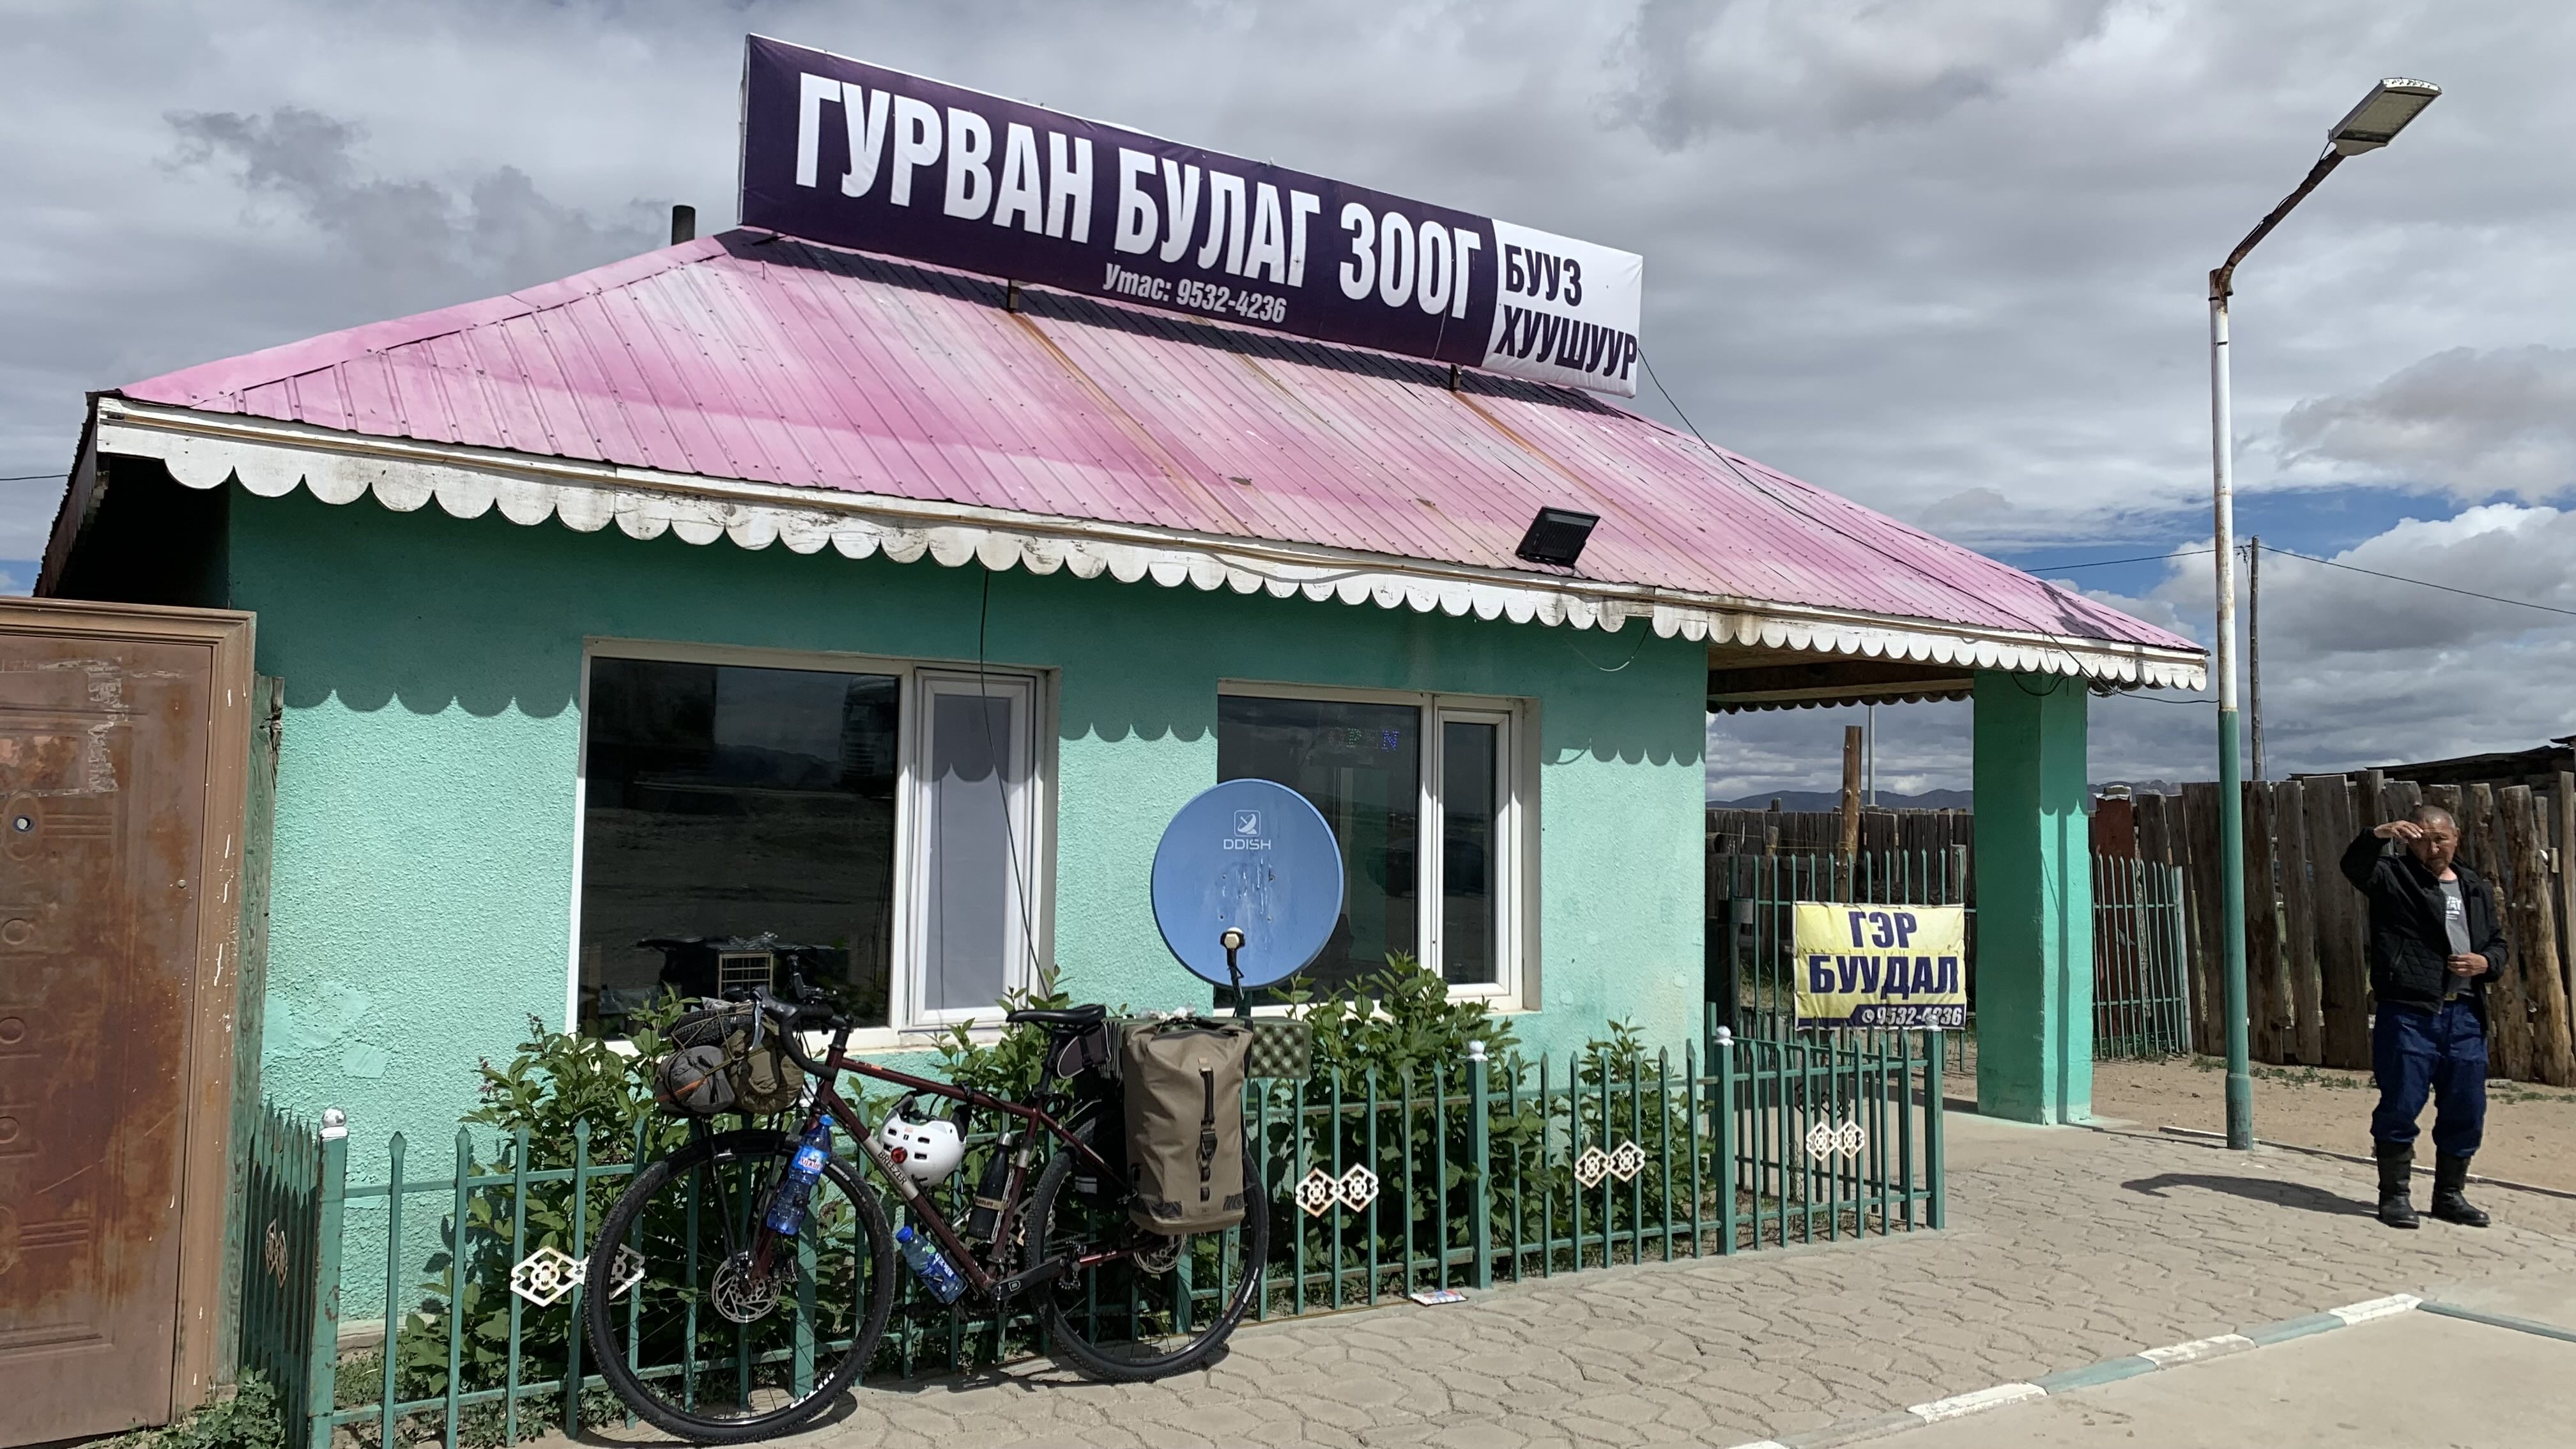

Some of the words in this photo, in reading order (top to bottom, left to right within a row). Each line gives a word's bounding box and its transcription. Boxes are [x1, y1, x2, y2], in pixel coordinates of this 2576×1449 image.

[795, 72, 1093, 243] ГУРВАН
[1114, 147, 1321, 288] БУЛАГ
[1339, 202, 1482, 319] ЗООГ
[1505, 243, 1583, 307] БУУЗ
[1176, 278, 1287, 324] 9532-4236
[1494, 305, 1638, 381] ХУУШУУР
[1223, 839, 1271, 850] DDISH
[1848, 910, 1918, 949] ГЭР
[1809, 955, 1959, 1000] БУУДАЛ
[878, 1150, 907, 1185] BREEZER
